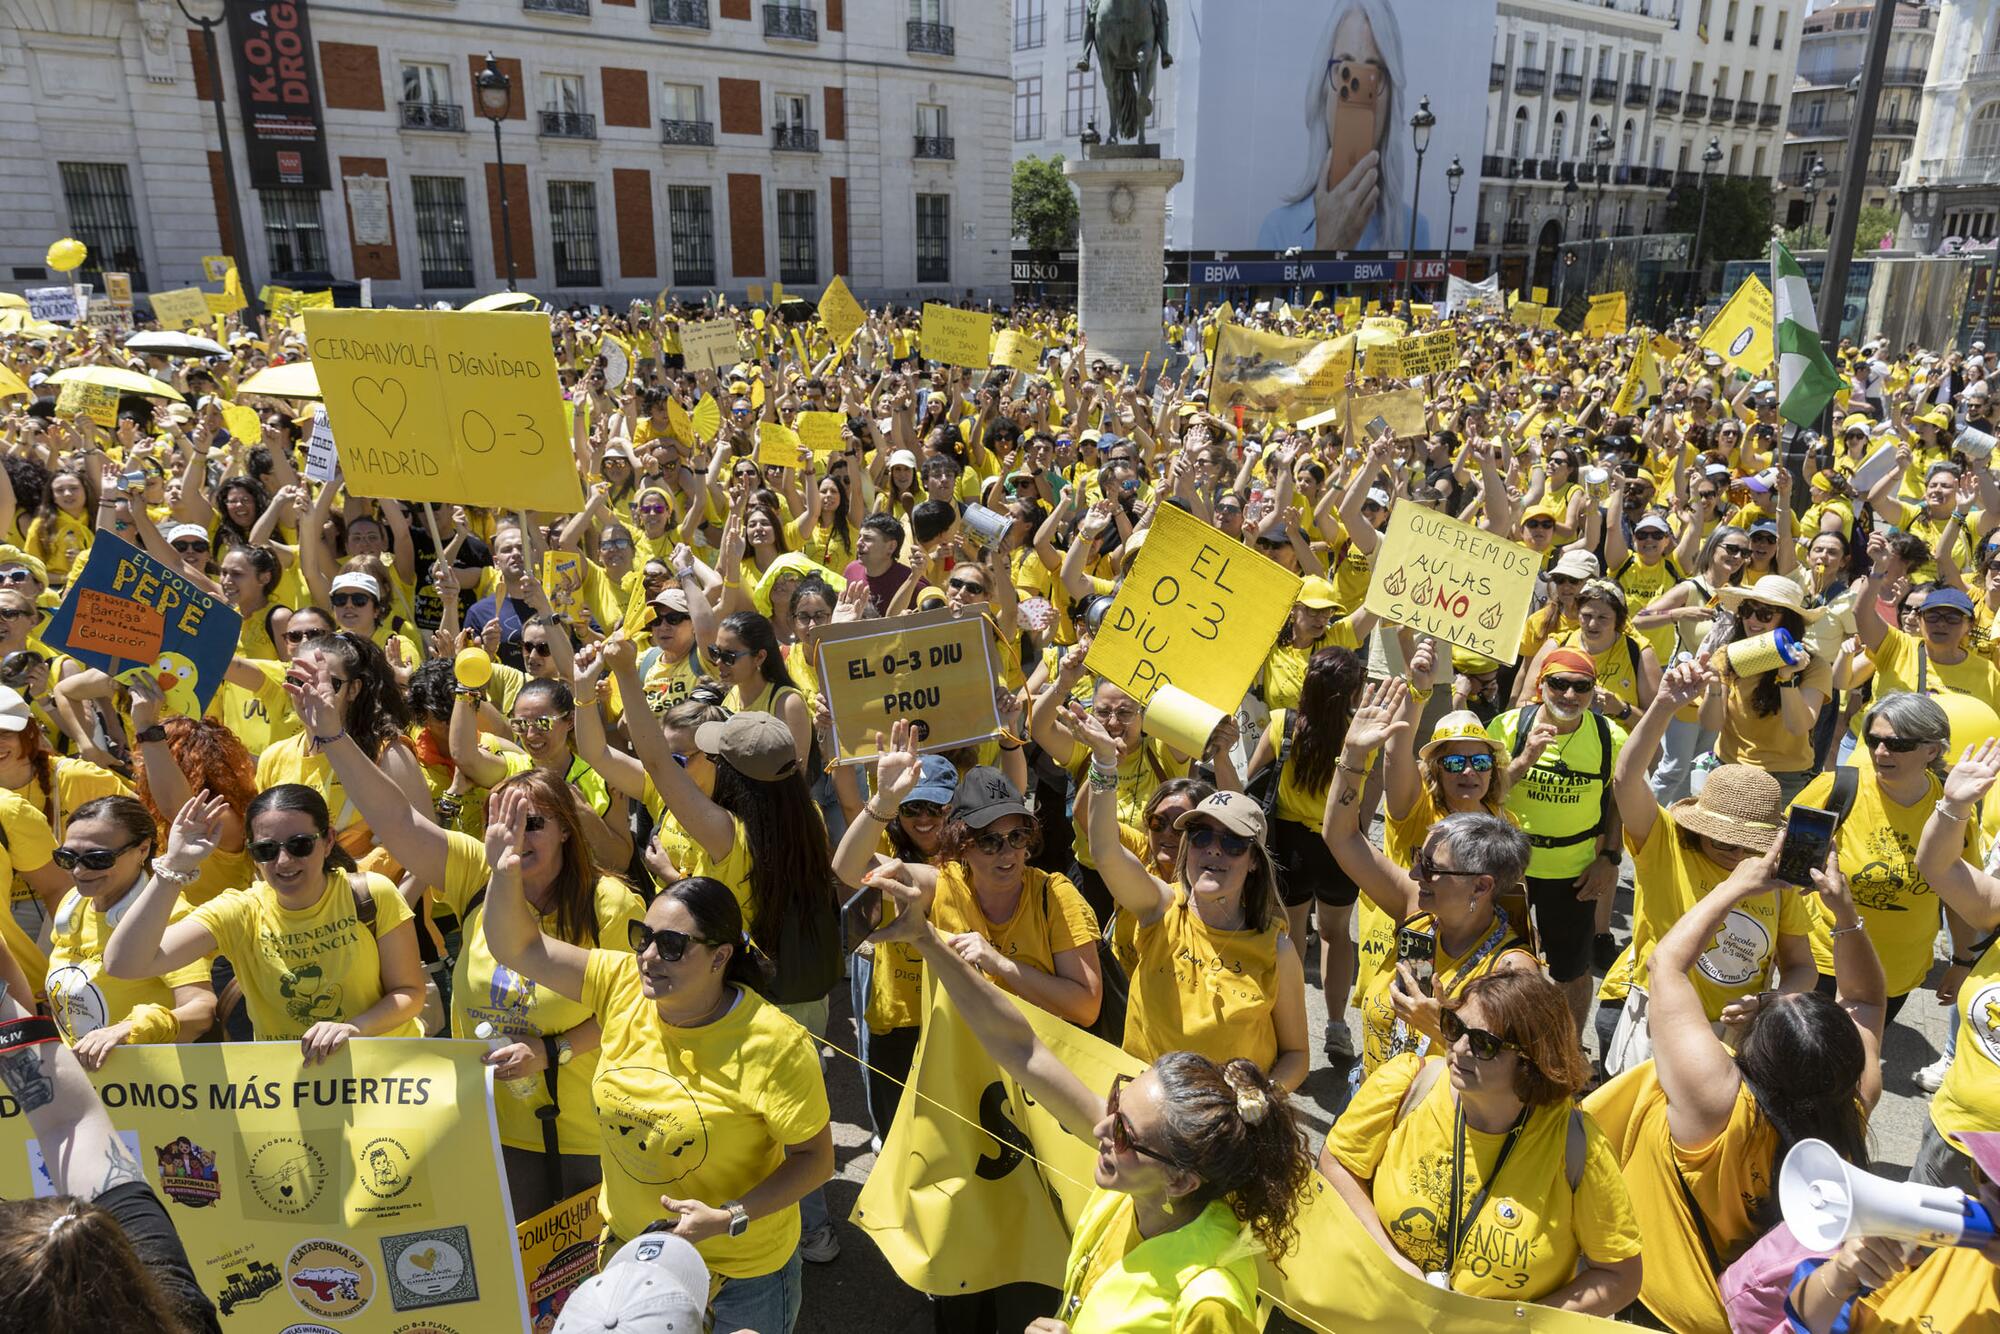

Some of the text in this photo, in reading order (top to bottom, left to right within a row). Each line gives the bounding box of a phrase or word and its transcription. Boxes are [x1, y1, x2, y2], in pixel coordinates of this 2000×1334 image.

[244, 30, 279, 102] K.O.
[270, 0, 310, 103] DROG
[1204, 265, 1240, 282] BBVA
[1354, 263, 1383, 279] BBVA
[1425, 262, 1451, 278] KF
[314, 338, 440, 371] CERDANYOLA
[1405, 365, 1431, 377] OTROS
[1434, 360, 1447, 373] 19
[461, 409, 545, 456] 0-3
[1410, 514, 1531, 577] QUEREMOS
[132, 553, 213, 610] EL POLLO
[1190, 543, 1234, 594] EL
[1410, 553, 1492, 596] AULAS
[112, 558, 205, 637] PEPE
[1152, 575, 1226, 641] 0-3
[1433, 583, 1470, 619] NO
[90, 602, 141, 623] Barriga
[79, 625, 147, 647] Educación
[1386, 603, 1496, 656] SAUNAS
[848, 658, 876, 681] EL
[929, 642, 963, 668] DIU
[883, 686, 941, 715] PROU
[1208, 791, 1234, 806] NY
[1526, 788, 1581, 804] MONTGRÍ
[1539, 785, 1572, 794] ULTRA
[284, 931, 359, 960] INFANCIA
[1722, 947, 1734, 957] 0-3
[1723, 939, 1755, 957] infantils
[1728, 932, 1758, 948] Escoles
[1700, 955, 1741, 981] Plataforma
[10, 1030, 23, 1041] IV
[93, 1074, 432, 1110] OMOS MÁS FUERTES
[249, 1137, 326, 1175] PLATAFORMA LABORAL
[251, 1179, 325, 1215] ESCUELAS INFANTILES
[518, 1194, 599, 1252] UARDAMO
[552, 1223, 582, 1253] NO
[290, 1241, 364, 1269] PLATAFORMA 0-3
[552, 1261, 598, 1289] ATAFORMA
[1471, 1255, 1530, 1290] 0-3
[300, 1298, 333, 1318] ESCUELAS
